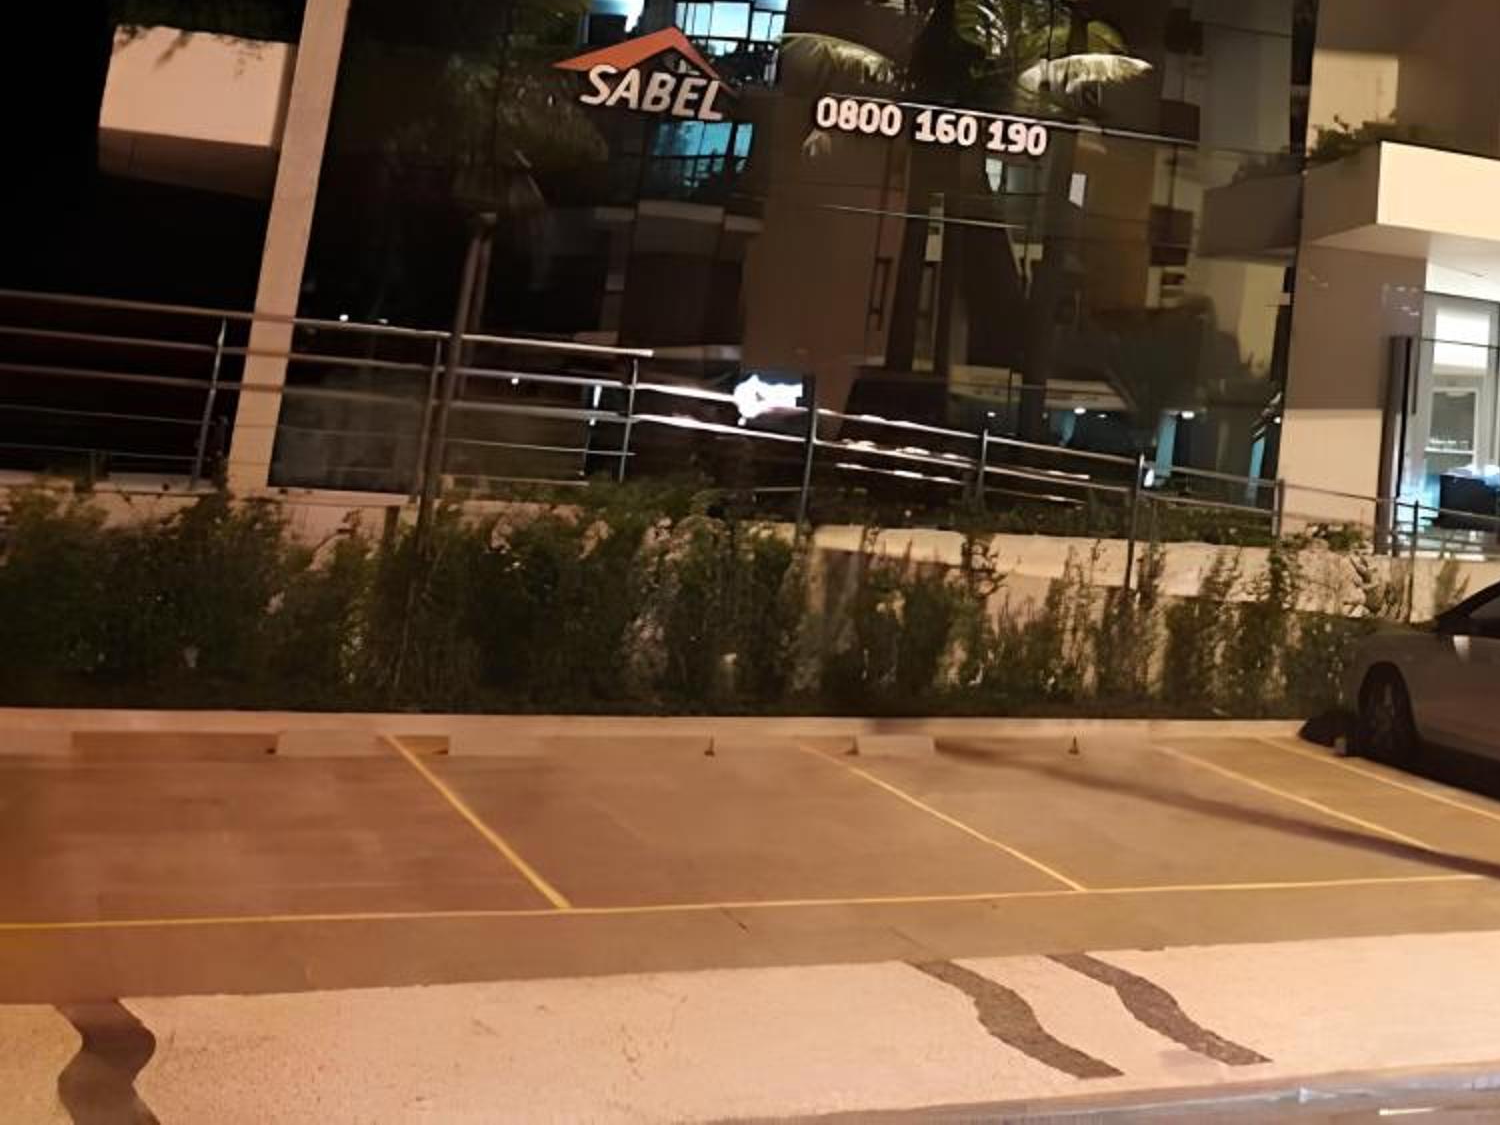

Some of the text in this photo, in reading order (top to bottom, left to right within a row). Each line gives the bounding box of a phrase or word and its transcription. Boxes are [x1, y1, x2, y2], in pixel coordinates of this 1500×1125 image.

[579, 64, 723, 121] SABEL
[816, 96, 1048, 156] 0800 160 190
